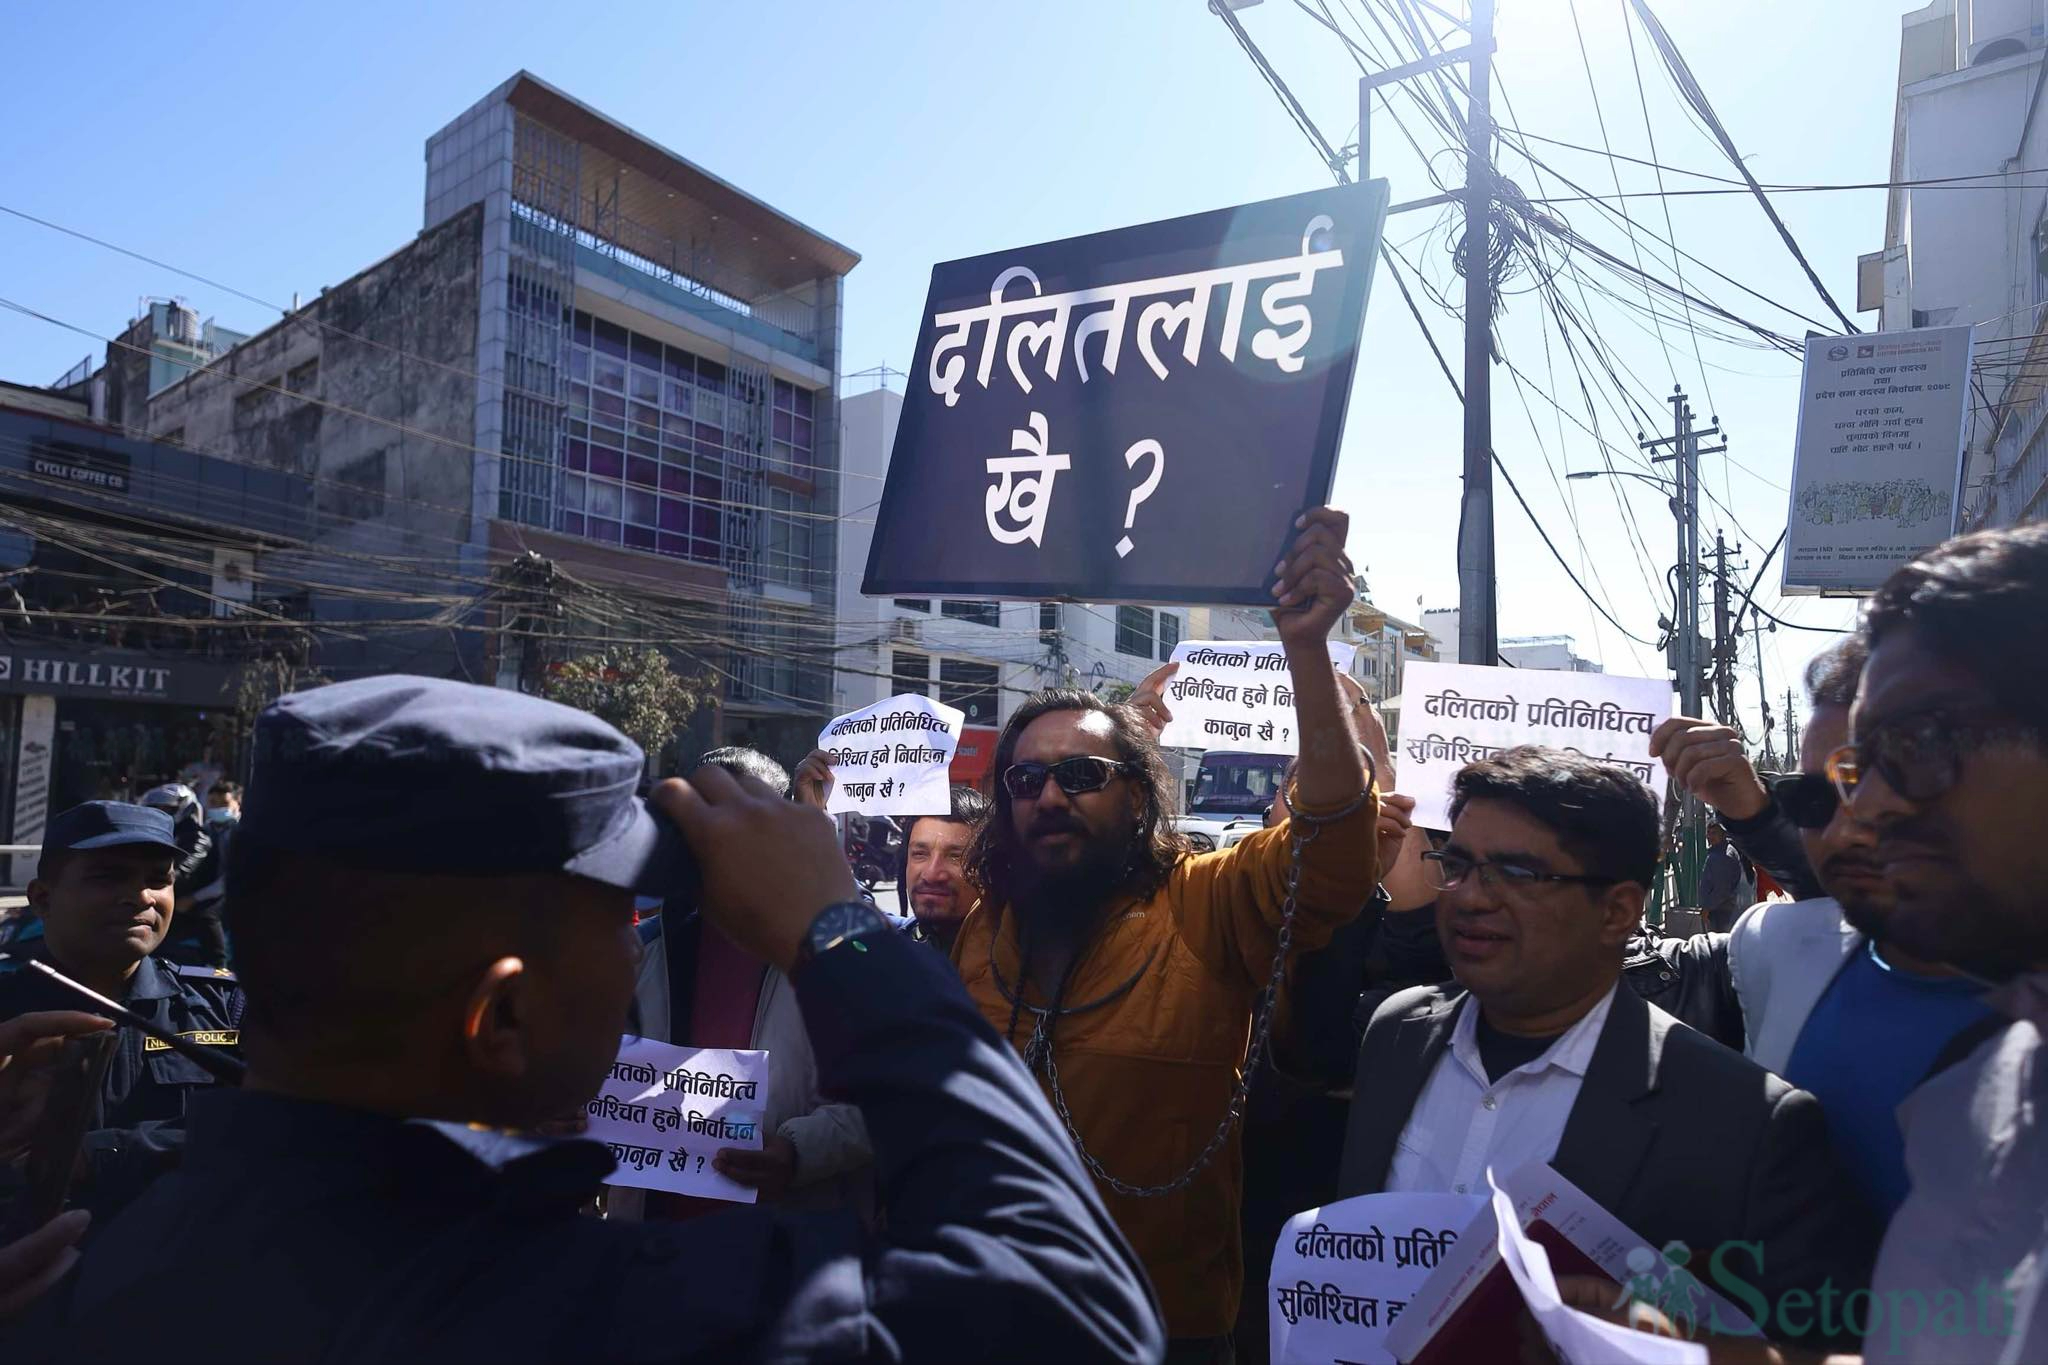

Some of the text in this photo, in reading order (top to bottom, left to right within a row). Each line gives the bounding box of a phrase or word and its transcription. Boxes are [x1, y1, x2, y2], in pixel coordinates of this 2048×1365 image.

[928, 214, 1344, 407] दलितलाई
[34, 460, 67, 478] CYCLE
[70, 466, 106, 485] COFFEE
[985, 411, 1164, 558] खै ?
[22, 659, 171, 690] HILLKIT
[1186, 648, 1250, 670] दलितको
[1170, 676, 1238, 702] सुनिश्चित
[1242, 684, 1270, 708] हुने
[830, 714, 877, 737] दलितको
[1424, 689, 1656, 735] दलितको प्रतिनिधित्व
[1204, 718, 1290, 743] कानुन खै ?
[870, 744, 891, 769] हुने
[893, 743, 947, 764] निर्वाचन
[879, 777, 895, 798] खै
[898, 782, 905, 797] ?
[195, 1033, 234, 1043] POLIC
[663, 1069, 758, 1101] प्रतिनिधित्व
[652, 1106, 683, 1133] हुने
[687, 1110, 757, 1141] निर्वाचन
[668, 1146, 689, 1172] खै
[696, 1156, 705, 1174] ?
[1294, 1223, 1386, 1263] दलितको
[1277, 1280, 1379, 1328] सुनिश्चित
